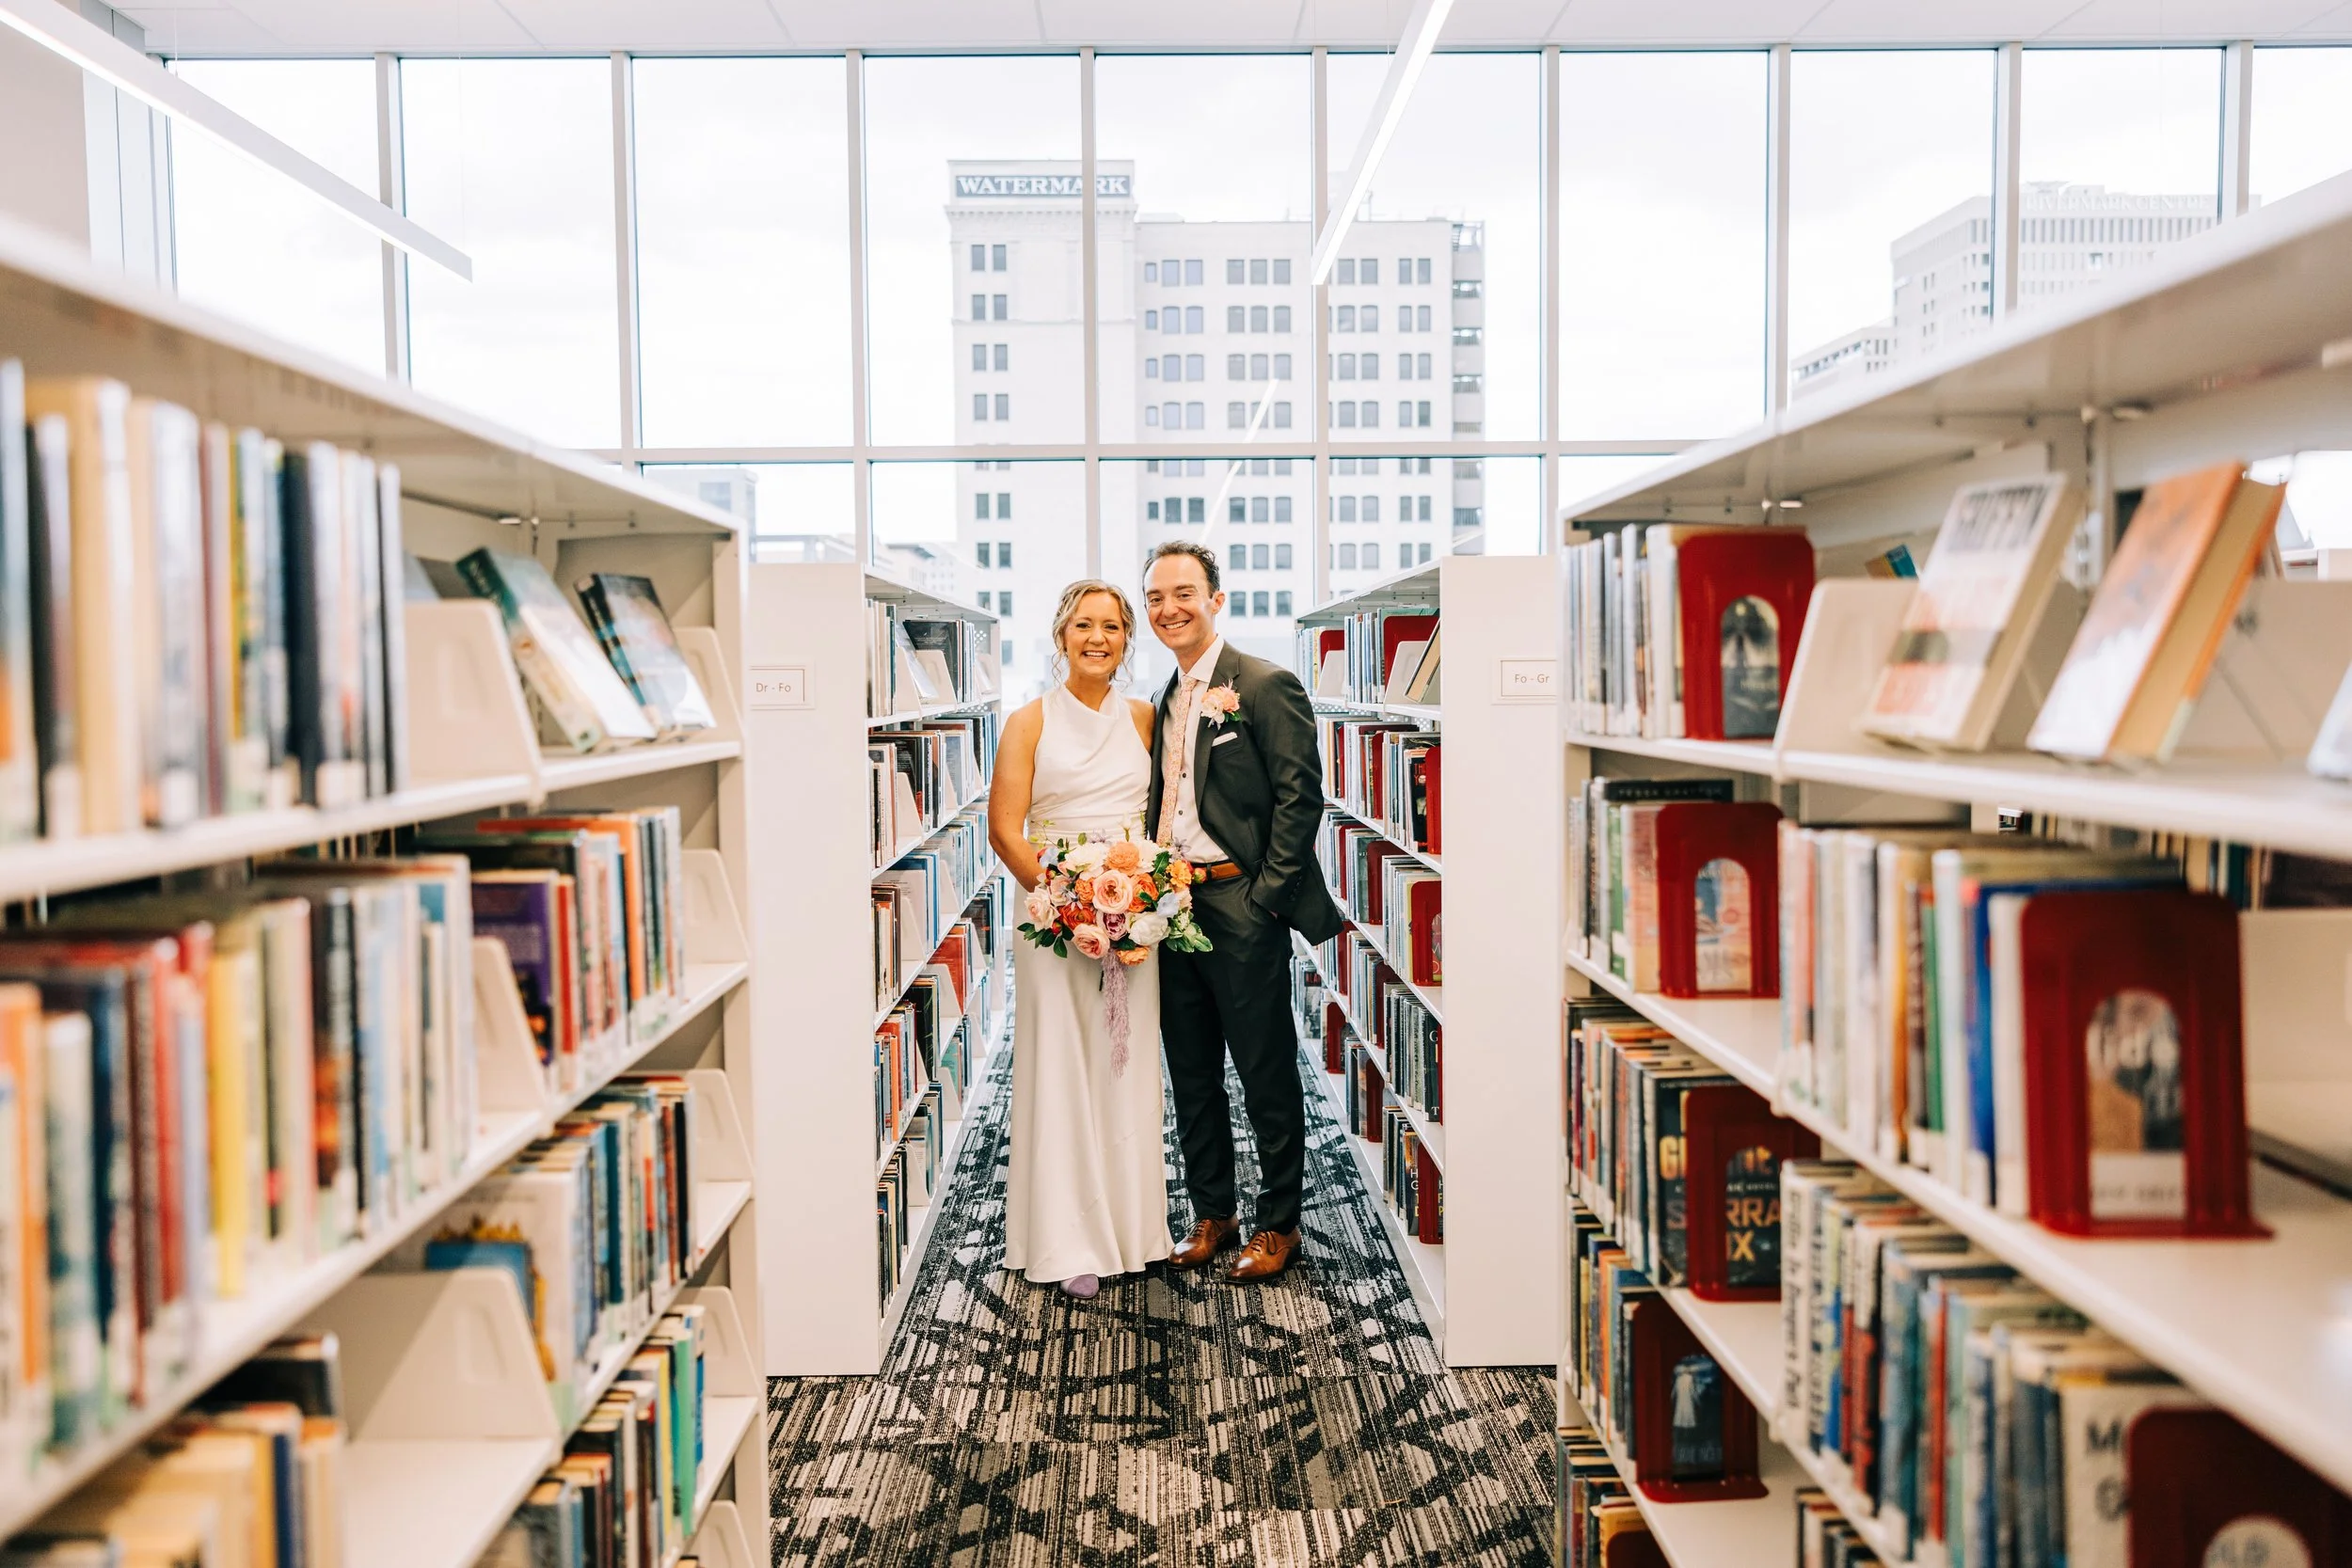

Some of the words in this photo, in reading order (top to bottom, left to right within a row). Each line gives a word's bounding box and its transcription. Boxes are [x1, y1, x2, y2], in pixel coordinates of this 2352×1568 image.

[958, 177, 1127, 194] WATERMARK
[1515, 673, 1528, 684] Fo
[1536, 673, 1550, 684] Gr
[755, 682, 769, 693] Dr
[778, 682, 791, 693] Fo
